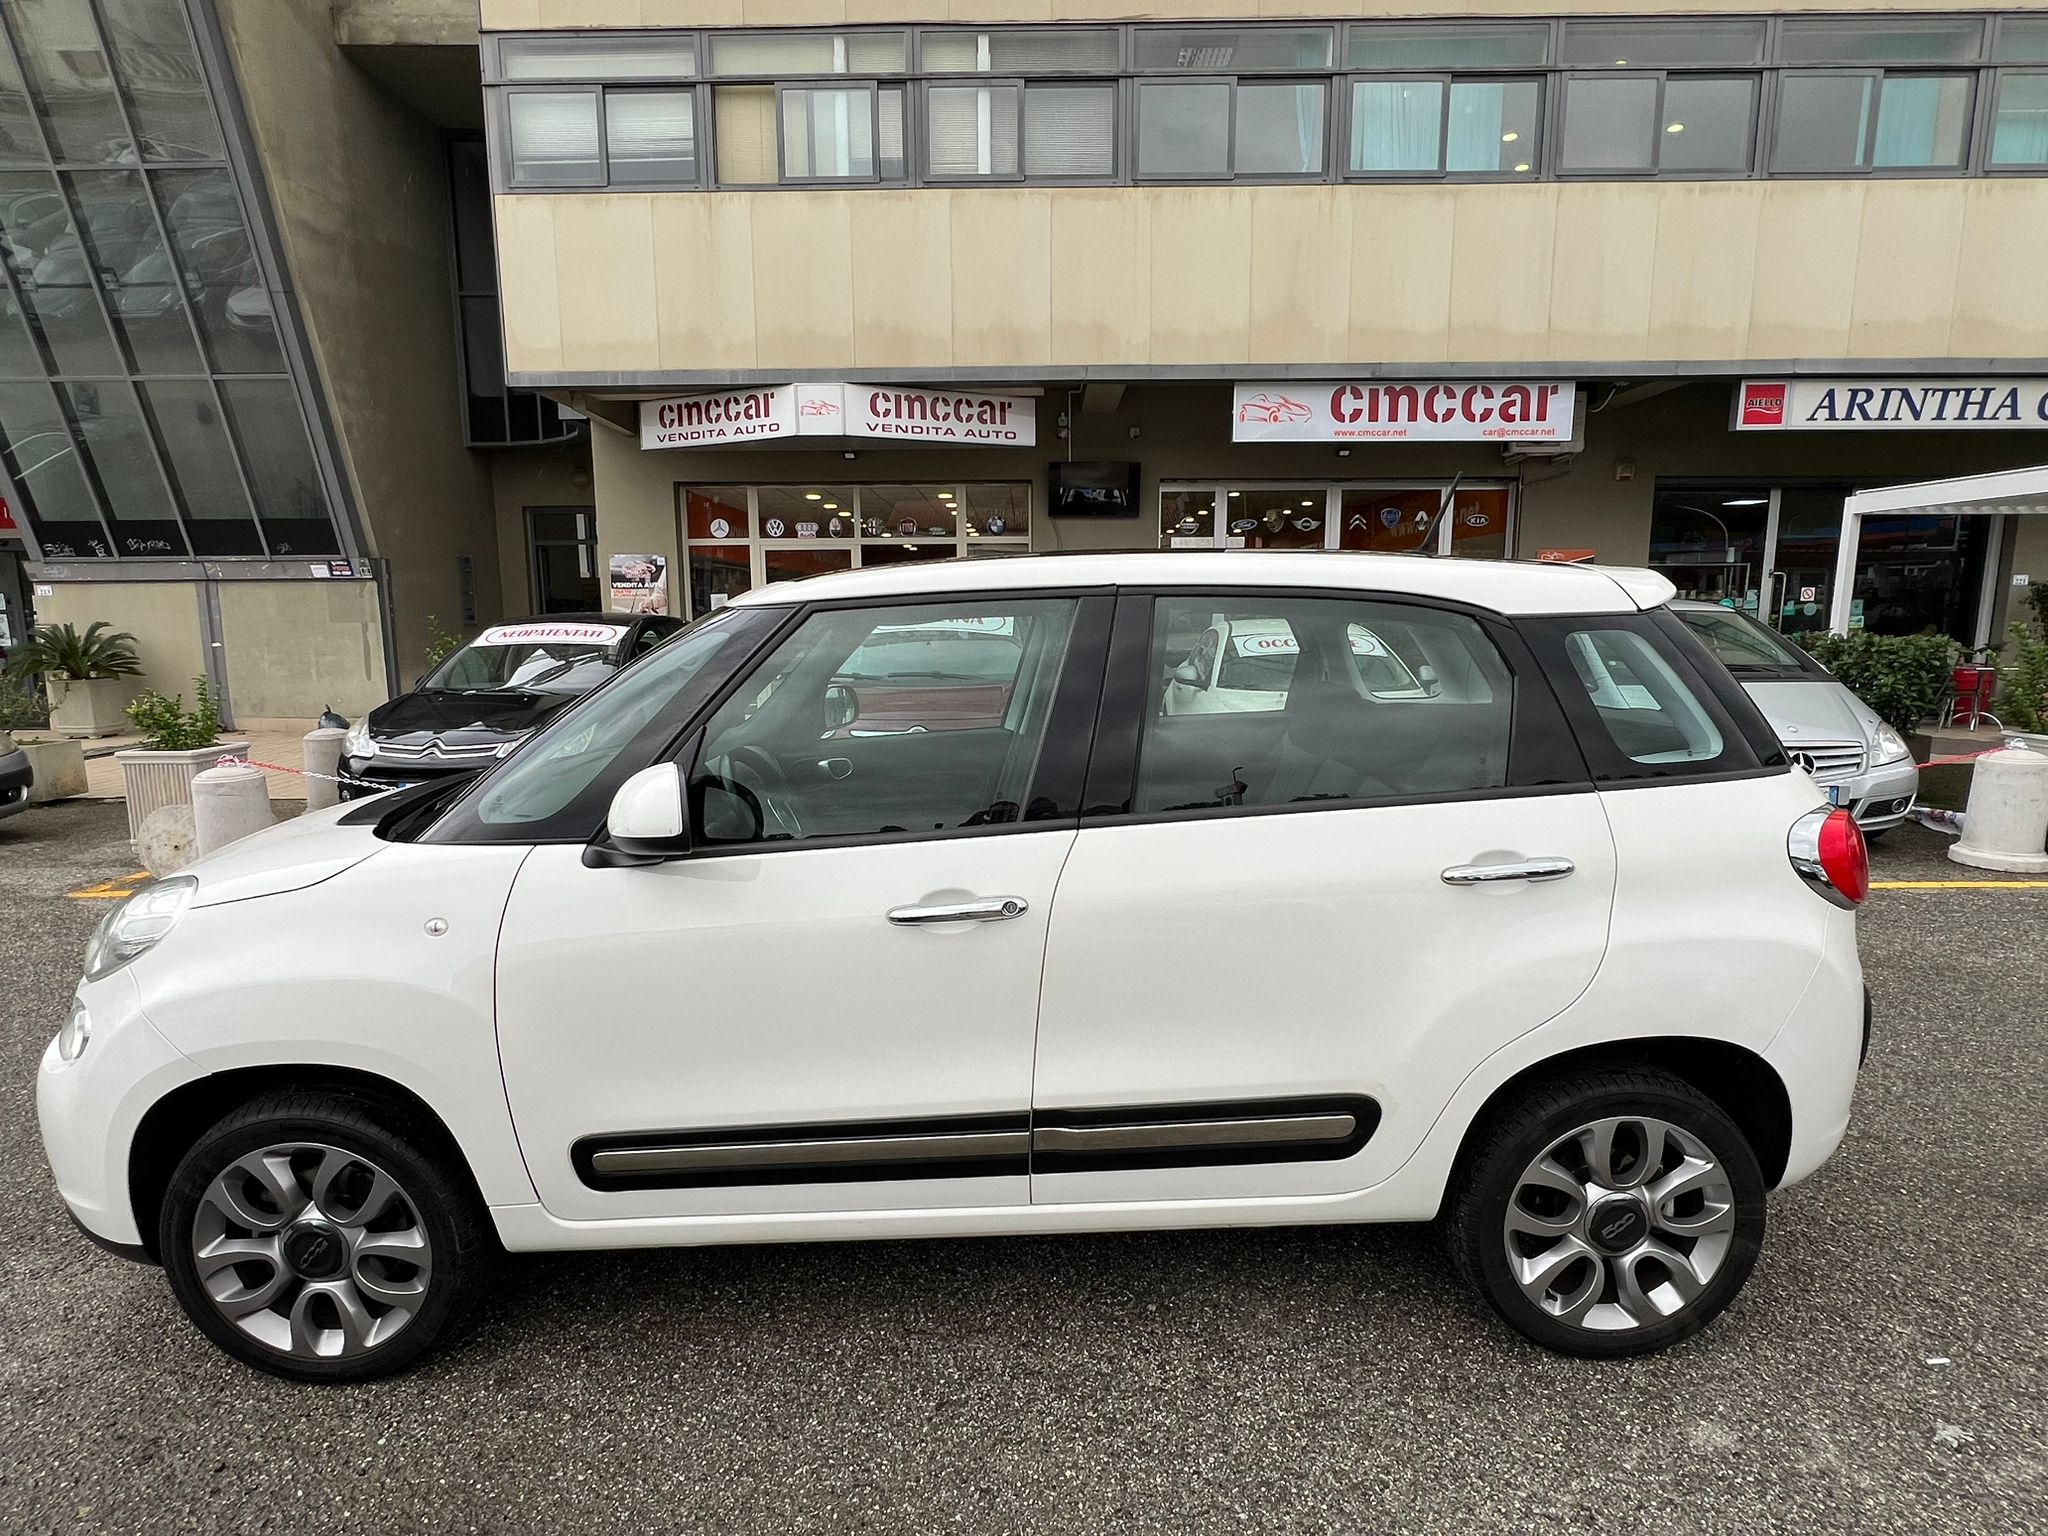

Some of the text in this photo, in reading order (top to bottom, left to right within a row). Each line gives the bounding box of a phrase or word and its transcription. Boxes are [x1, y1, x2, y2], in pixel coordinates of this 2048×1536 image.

[658, 391, 775, 429] cmccar
[869, 392, 1012, 426] cmccar
[1330, 384, 1559, 424] cmccar
[1747, 397, 1782, 408] AIELLO
[1806, 387, 2022, 421] ARINTHA
[656, 422, 780, 443] VENDITA AUTO
[866, 422, 1017, 440] VENDITA AUTO
[1333, 428, 1408, 437] www.cmccar.net
[1482, 427, 1556, 438] car@cmccar.net
[498, 628, 604, 639] NEOPATENTATI
